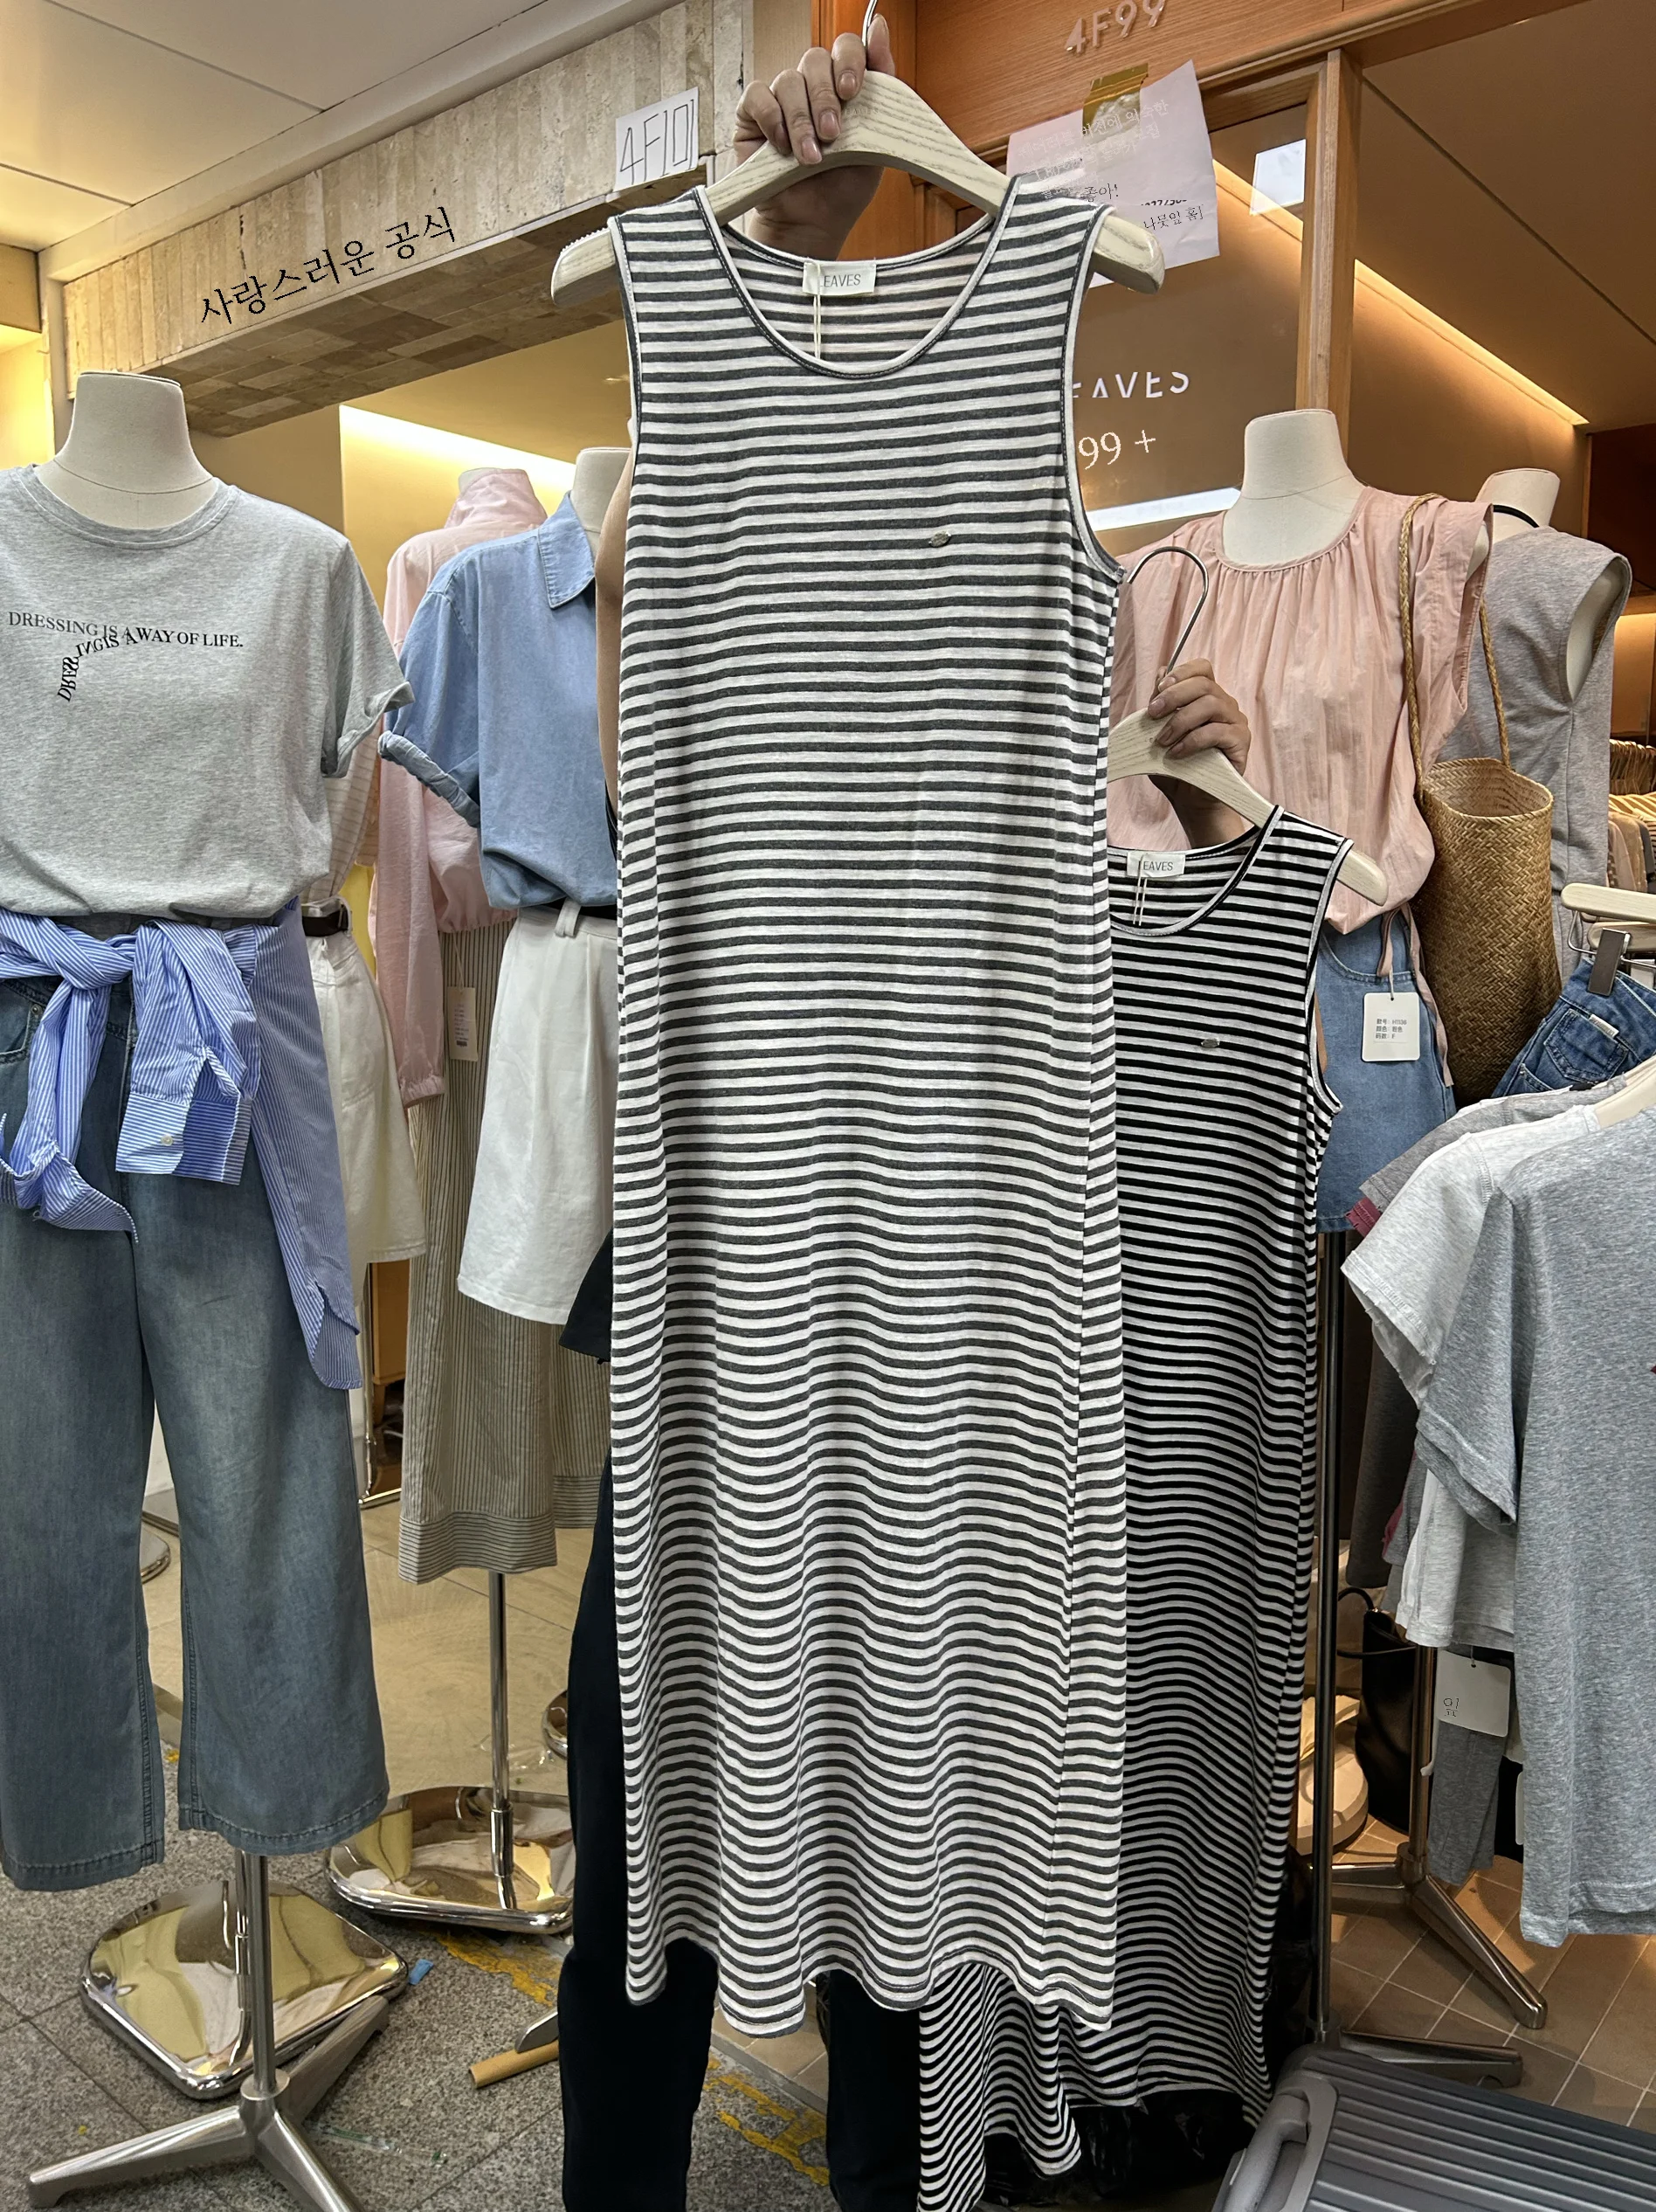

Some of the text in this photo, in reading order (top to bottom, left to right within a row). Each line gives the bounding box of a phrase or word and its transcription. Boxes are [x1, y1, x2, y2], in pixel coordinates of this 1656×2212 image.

[1065, 0, 1165, 54] 4F99
[201, 206, 455, 324] 사랑스러운 공식
[820, 273, 861, 287] EAVES
[9, 612, 98, 637] DRESSING
[103, 625, 118, 639] IS
[135, 627, 175, 644] WAY
[176, 632, 200, 645] OF
[203, 633, 244, 647] LIFE.
